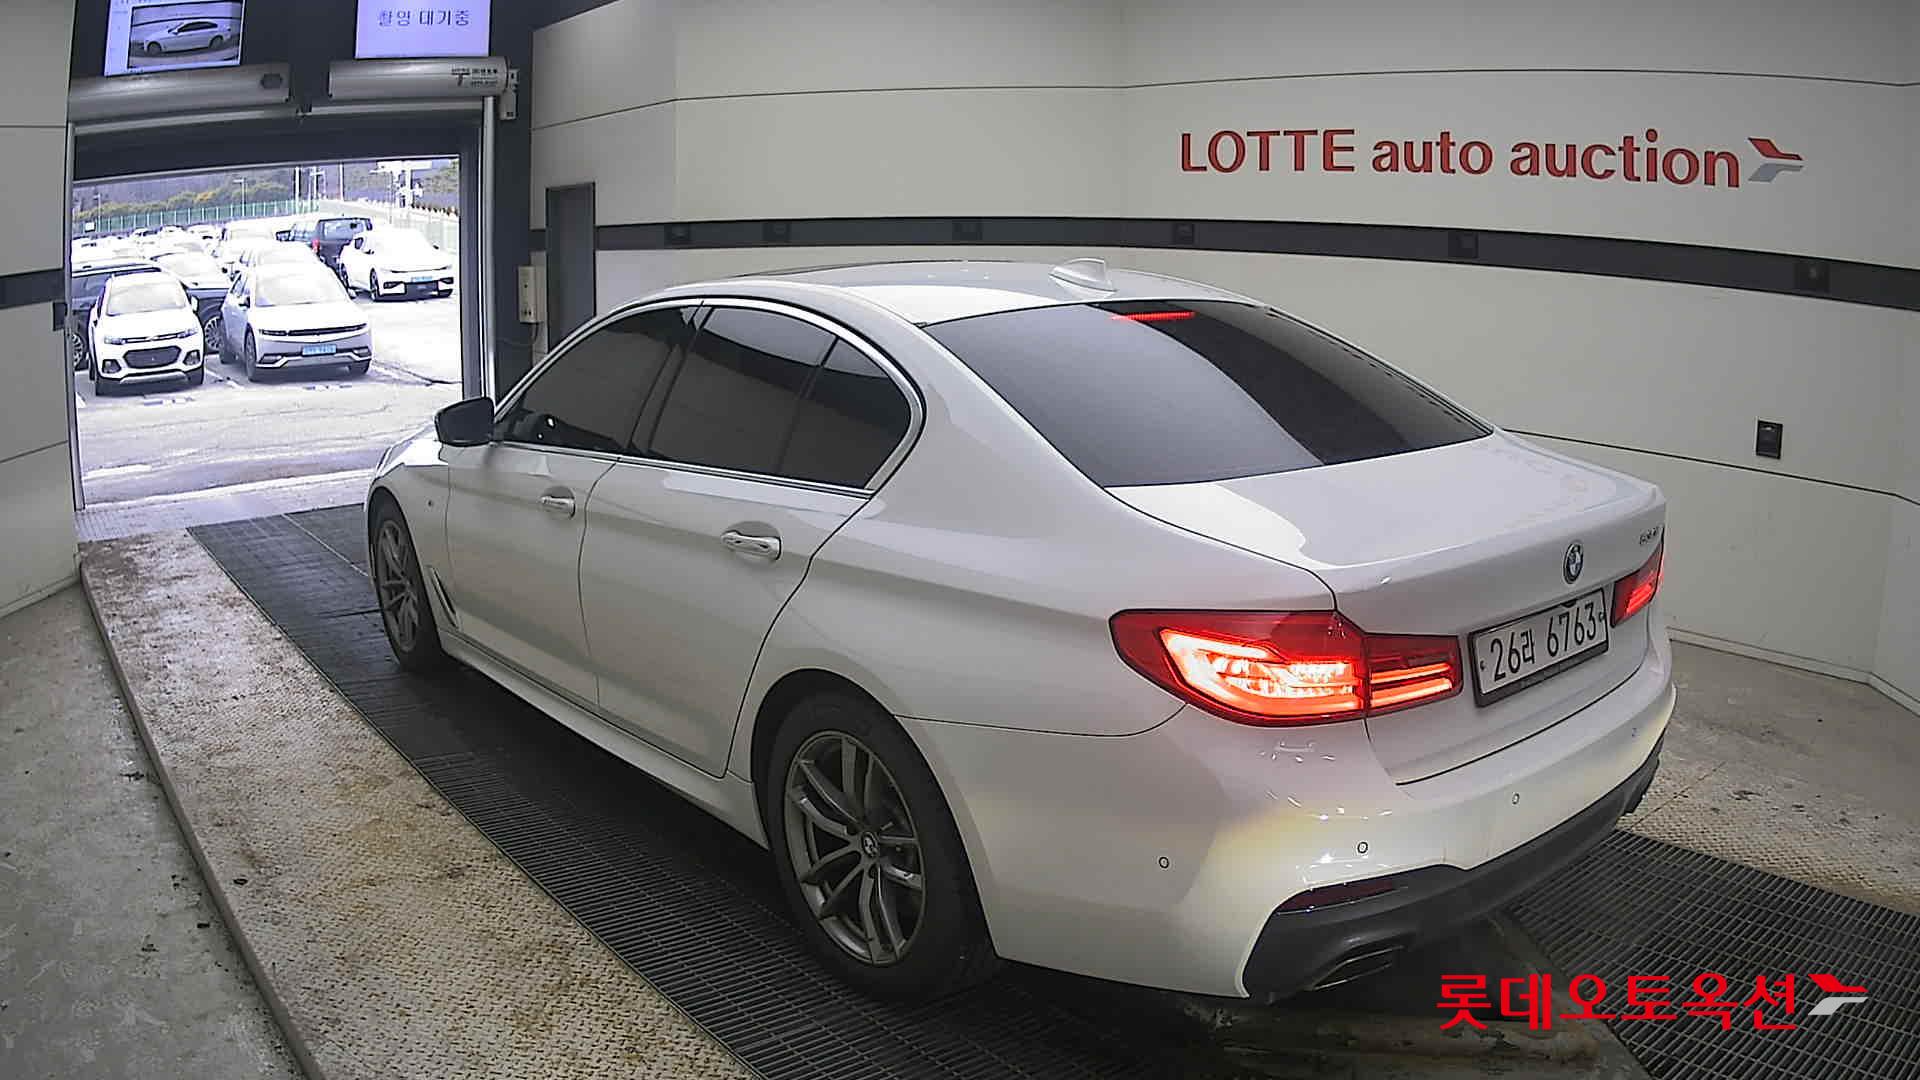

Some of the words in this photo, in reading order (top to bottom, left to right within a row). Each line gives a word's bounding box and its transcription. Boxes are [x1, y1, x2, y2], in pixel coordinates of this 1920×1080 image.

[419, 9, 470, 26] 대기중
[1181, 128, 1354, 173] LOTTE
[1372, 132, 1494, 175] auto
[1510, 129, 1742, 188] auction
[1490, 627, 1536, 682] 26라
[1546, 601, 1597, 658] 6763
